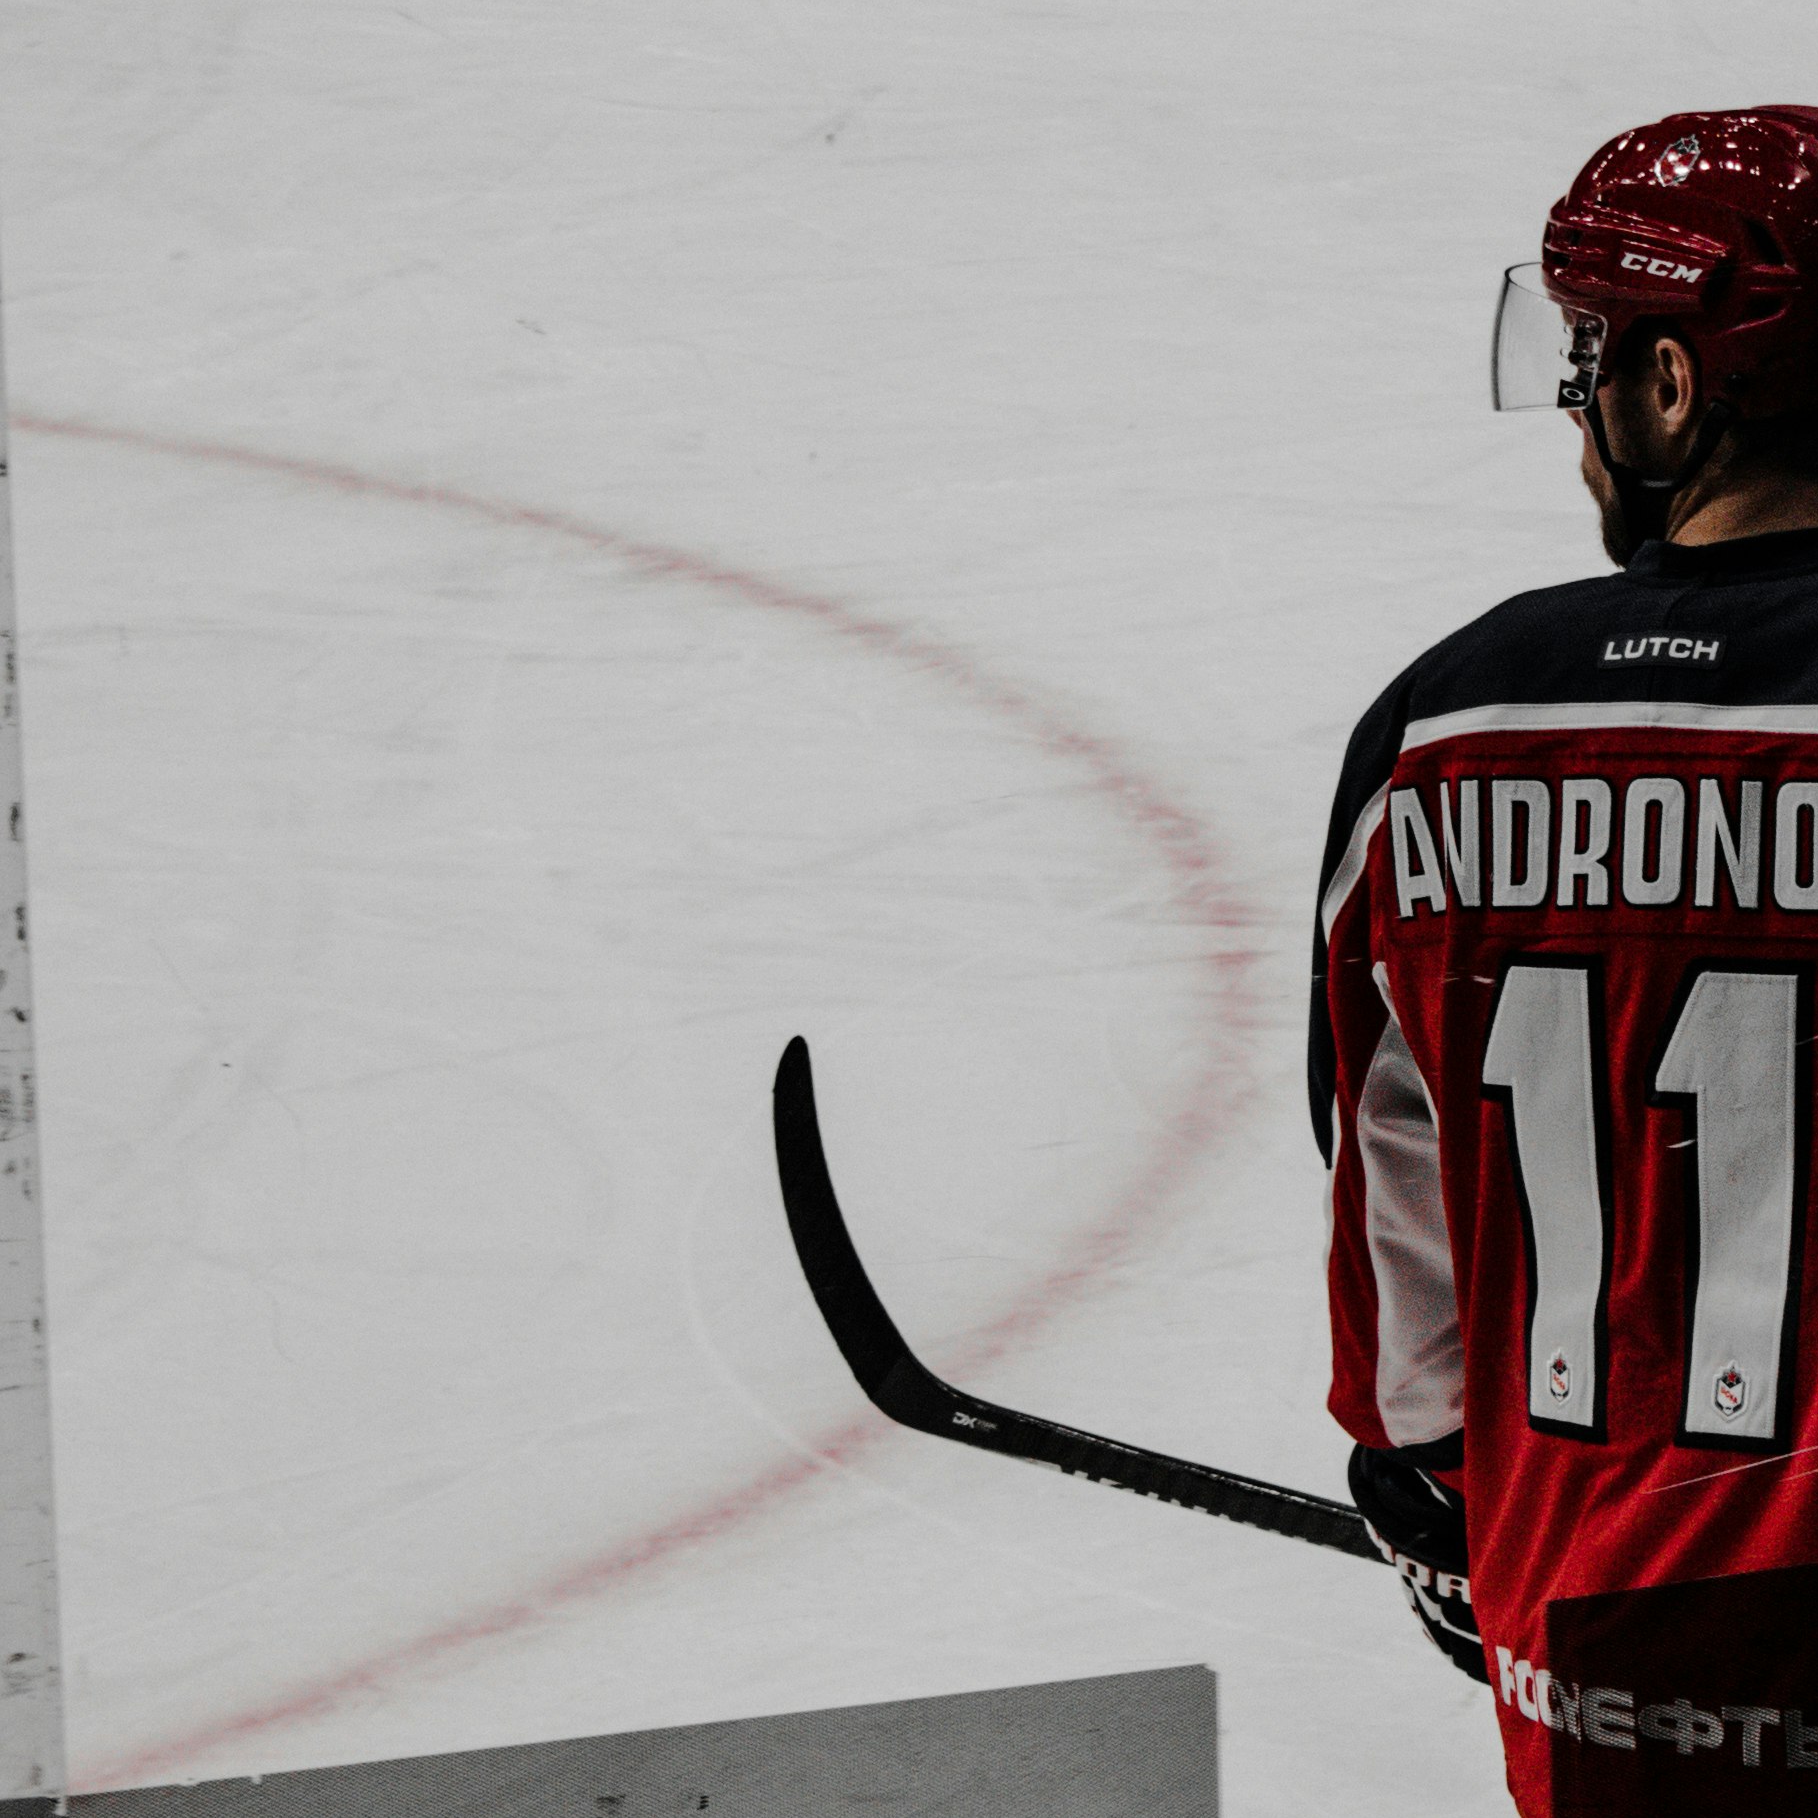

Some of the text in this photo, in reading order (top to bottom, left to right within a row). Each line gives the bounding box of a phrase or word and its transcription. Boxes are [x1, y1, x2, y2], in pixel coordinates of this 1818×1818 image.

[1620, 251, 1704, 283] CCM
[1604, 636, 1720, 662] LUTCH
[1481, 965, 1800, 1440] 11
